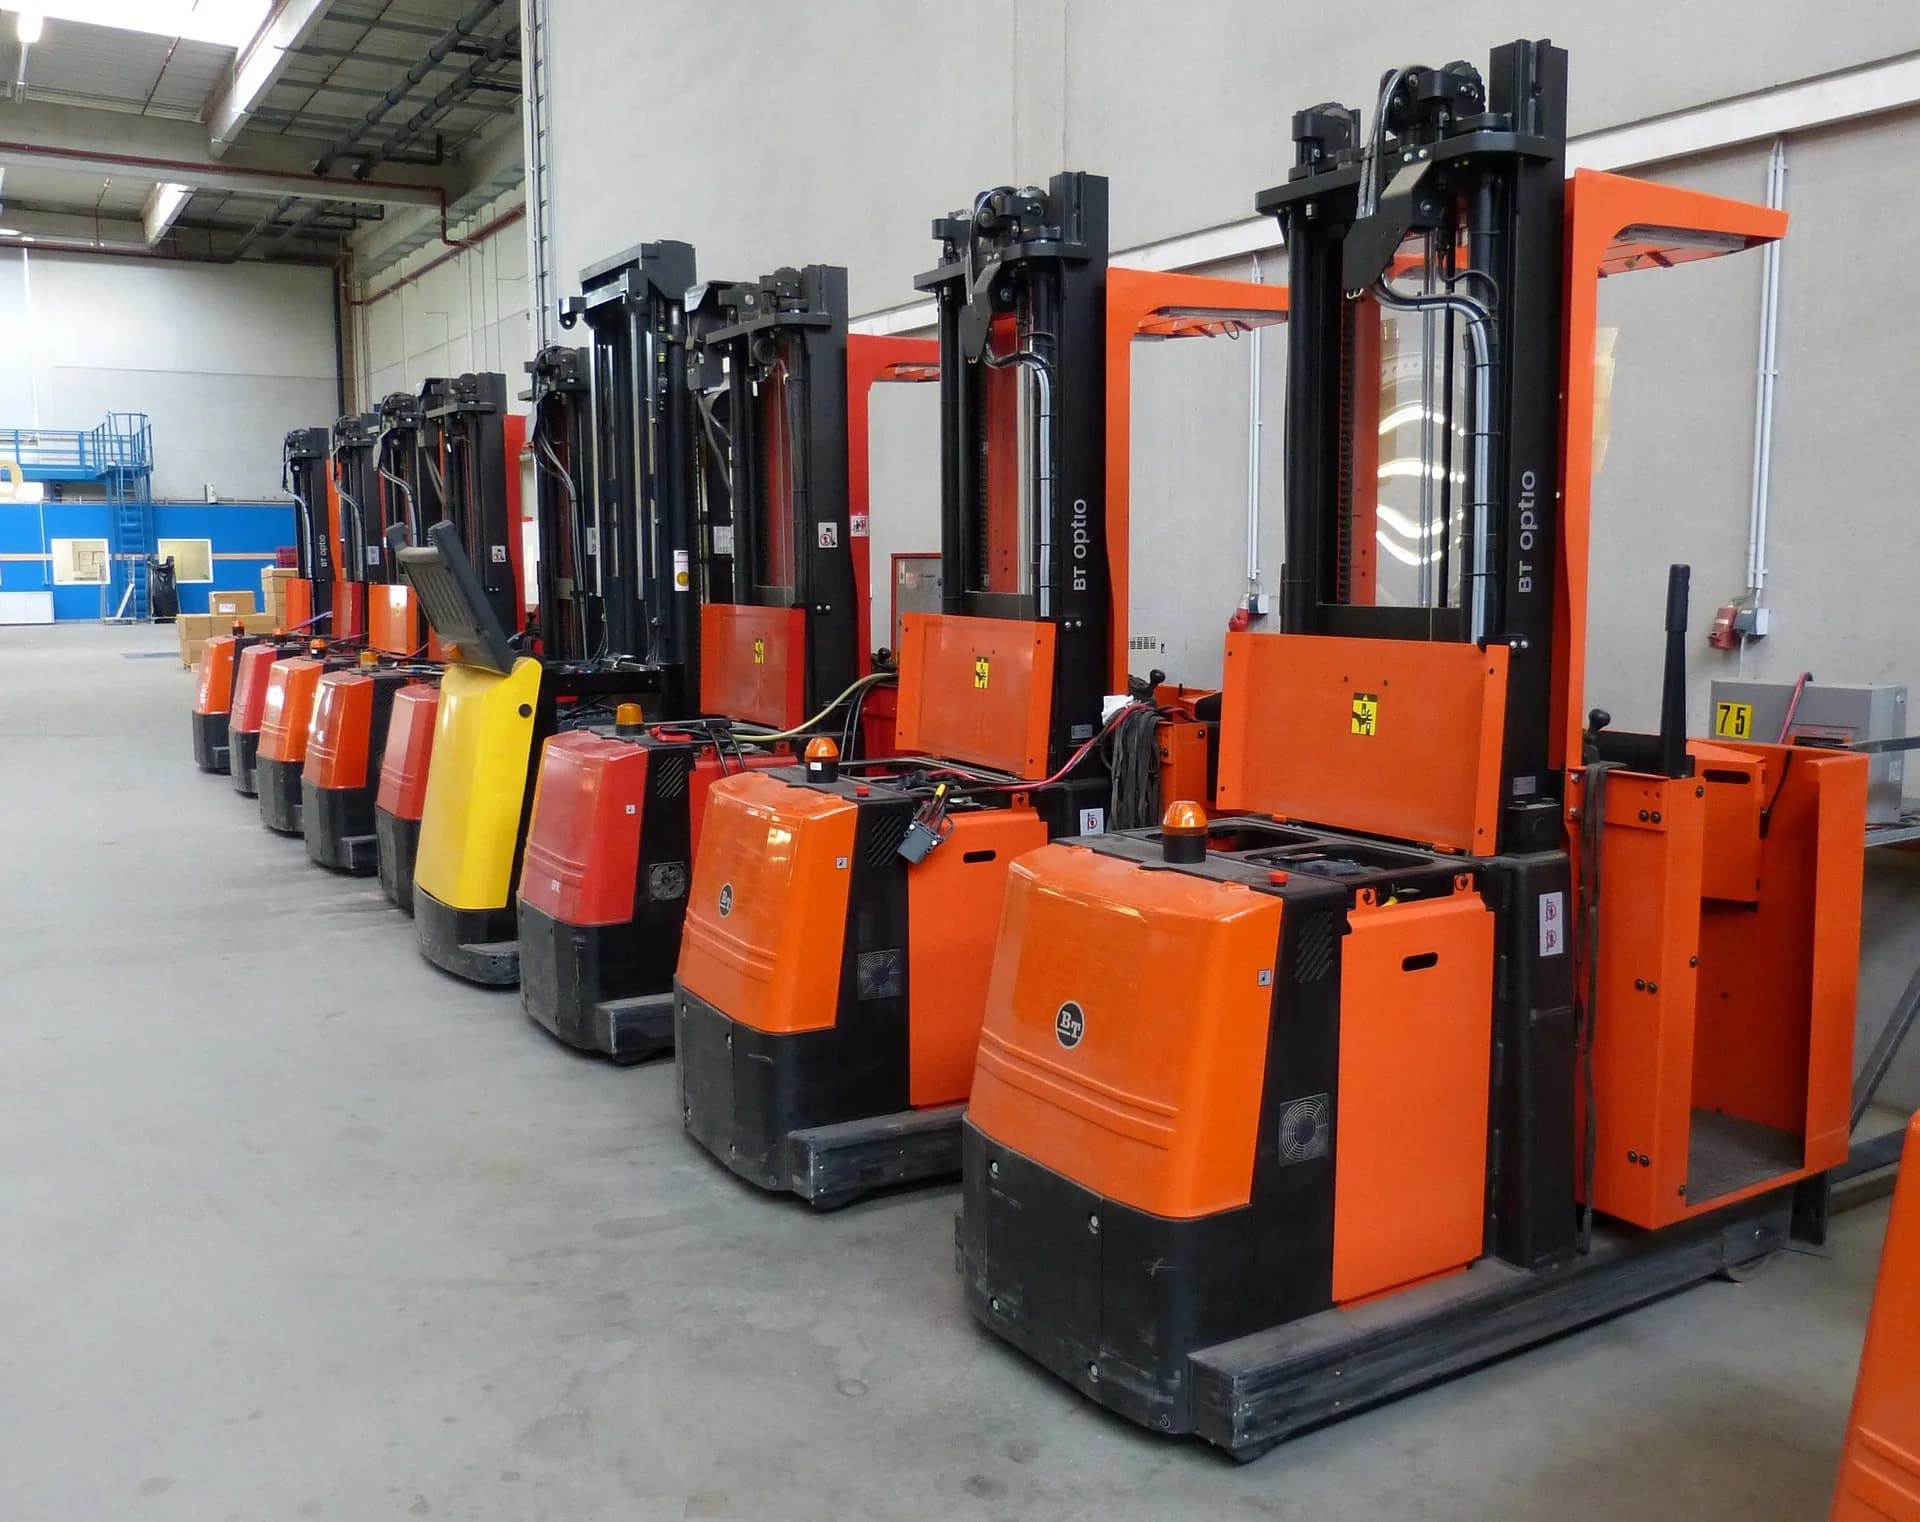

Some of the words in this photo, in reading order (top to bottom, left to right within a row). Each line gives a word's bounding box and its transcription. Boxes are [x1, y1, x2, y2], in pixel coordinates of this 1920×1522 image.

[1518, 470, 1538, 551] optio
[1071, 499, 1091, 559] optio
[1073, 566, 1087, 591] BT
[1518, 560, 1532, 593] BT
[1719, 704, 1746, 736] 75
[1058, 1009, 1083, 1040] BT
